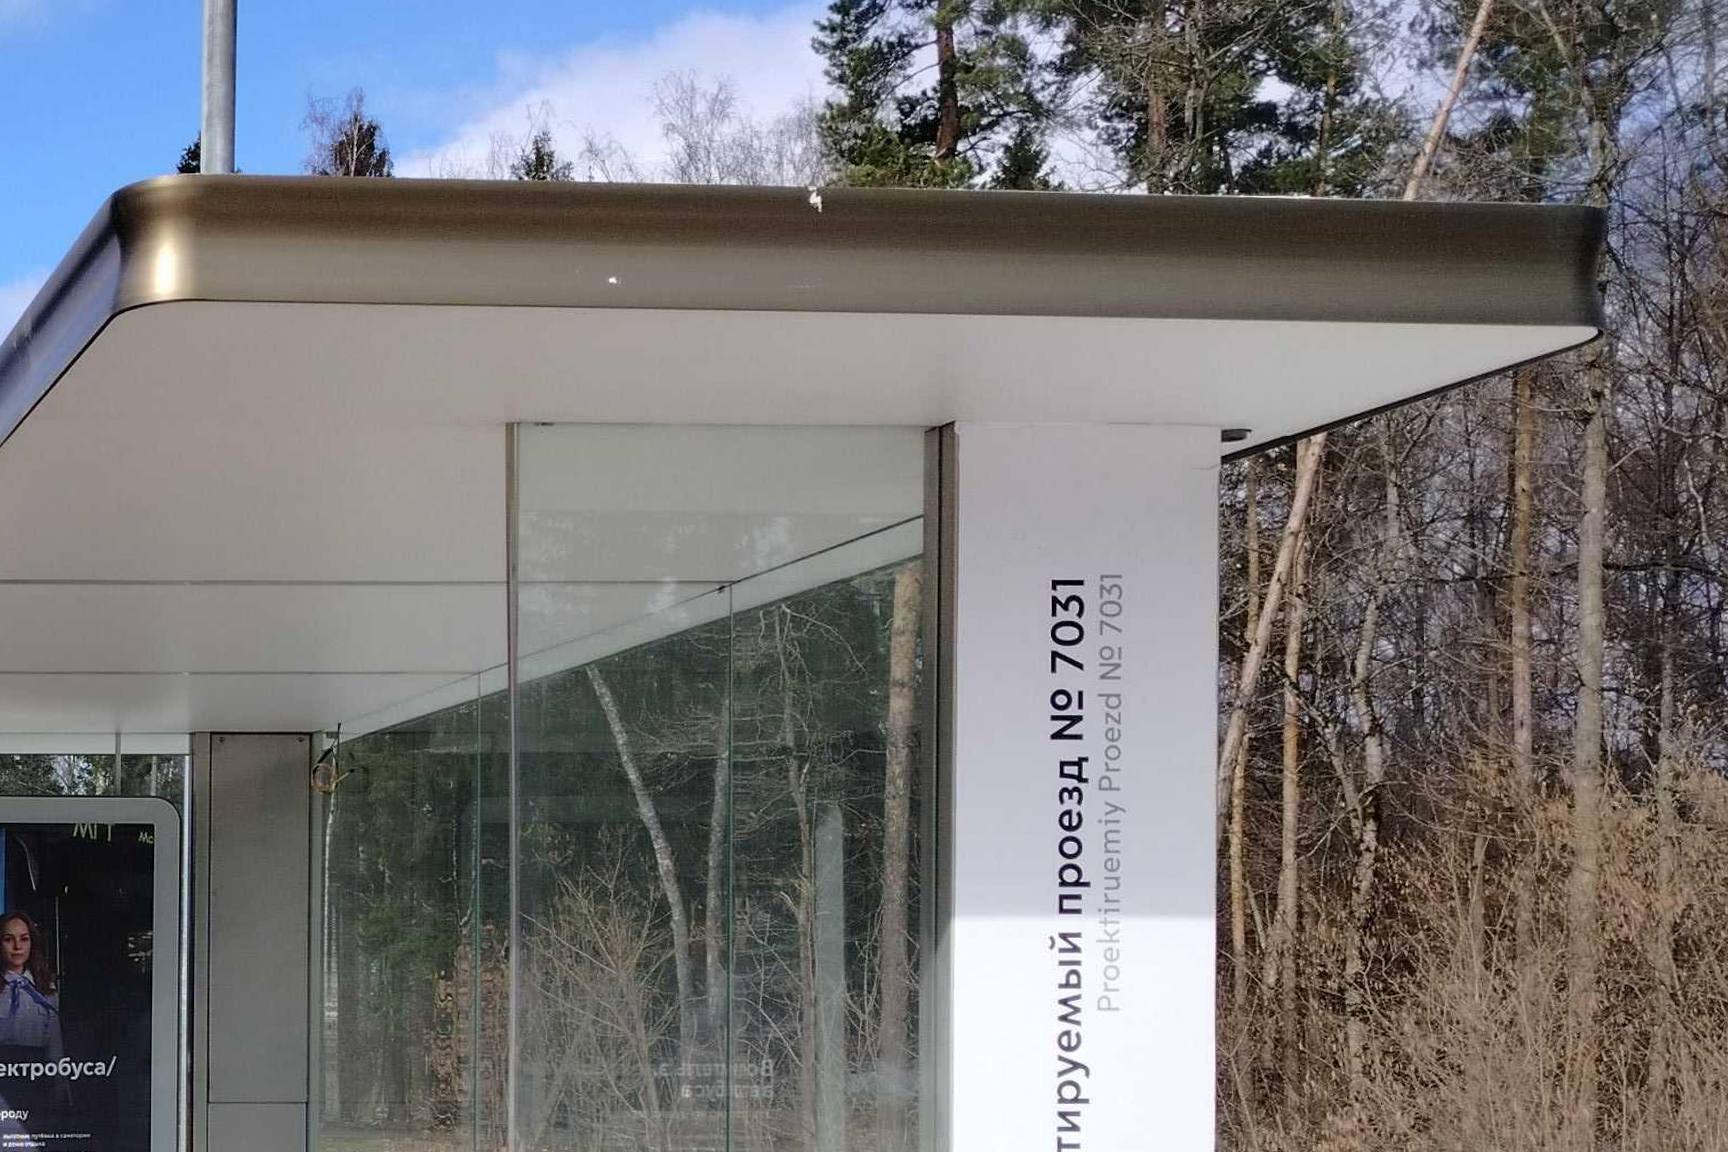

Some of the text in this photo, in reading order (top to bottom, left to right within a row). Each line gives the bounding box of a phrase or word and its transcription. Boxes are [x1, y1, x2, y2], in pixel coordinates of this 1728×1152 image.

[1050, 579, 1085, 674] 7031
[1049, 688, 1084, 741] №
[1057, 756, 1091, 915] проезд
[1095, 573, 1127, 1012] Proektiruemiy Proezd № 7031
